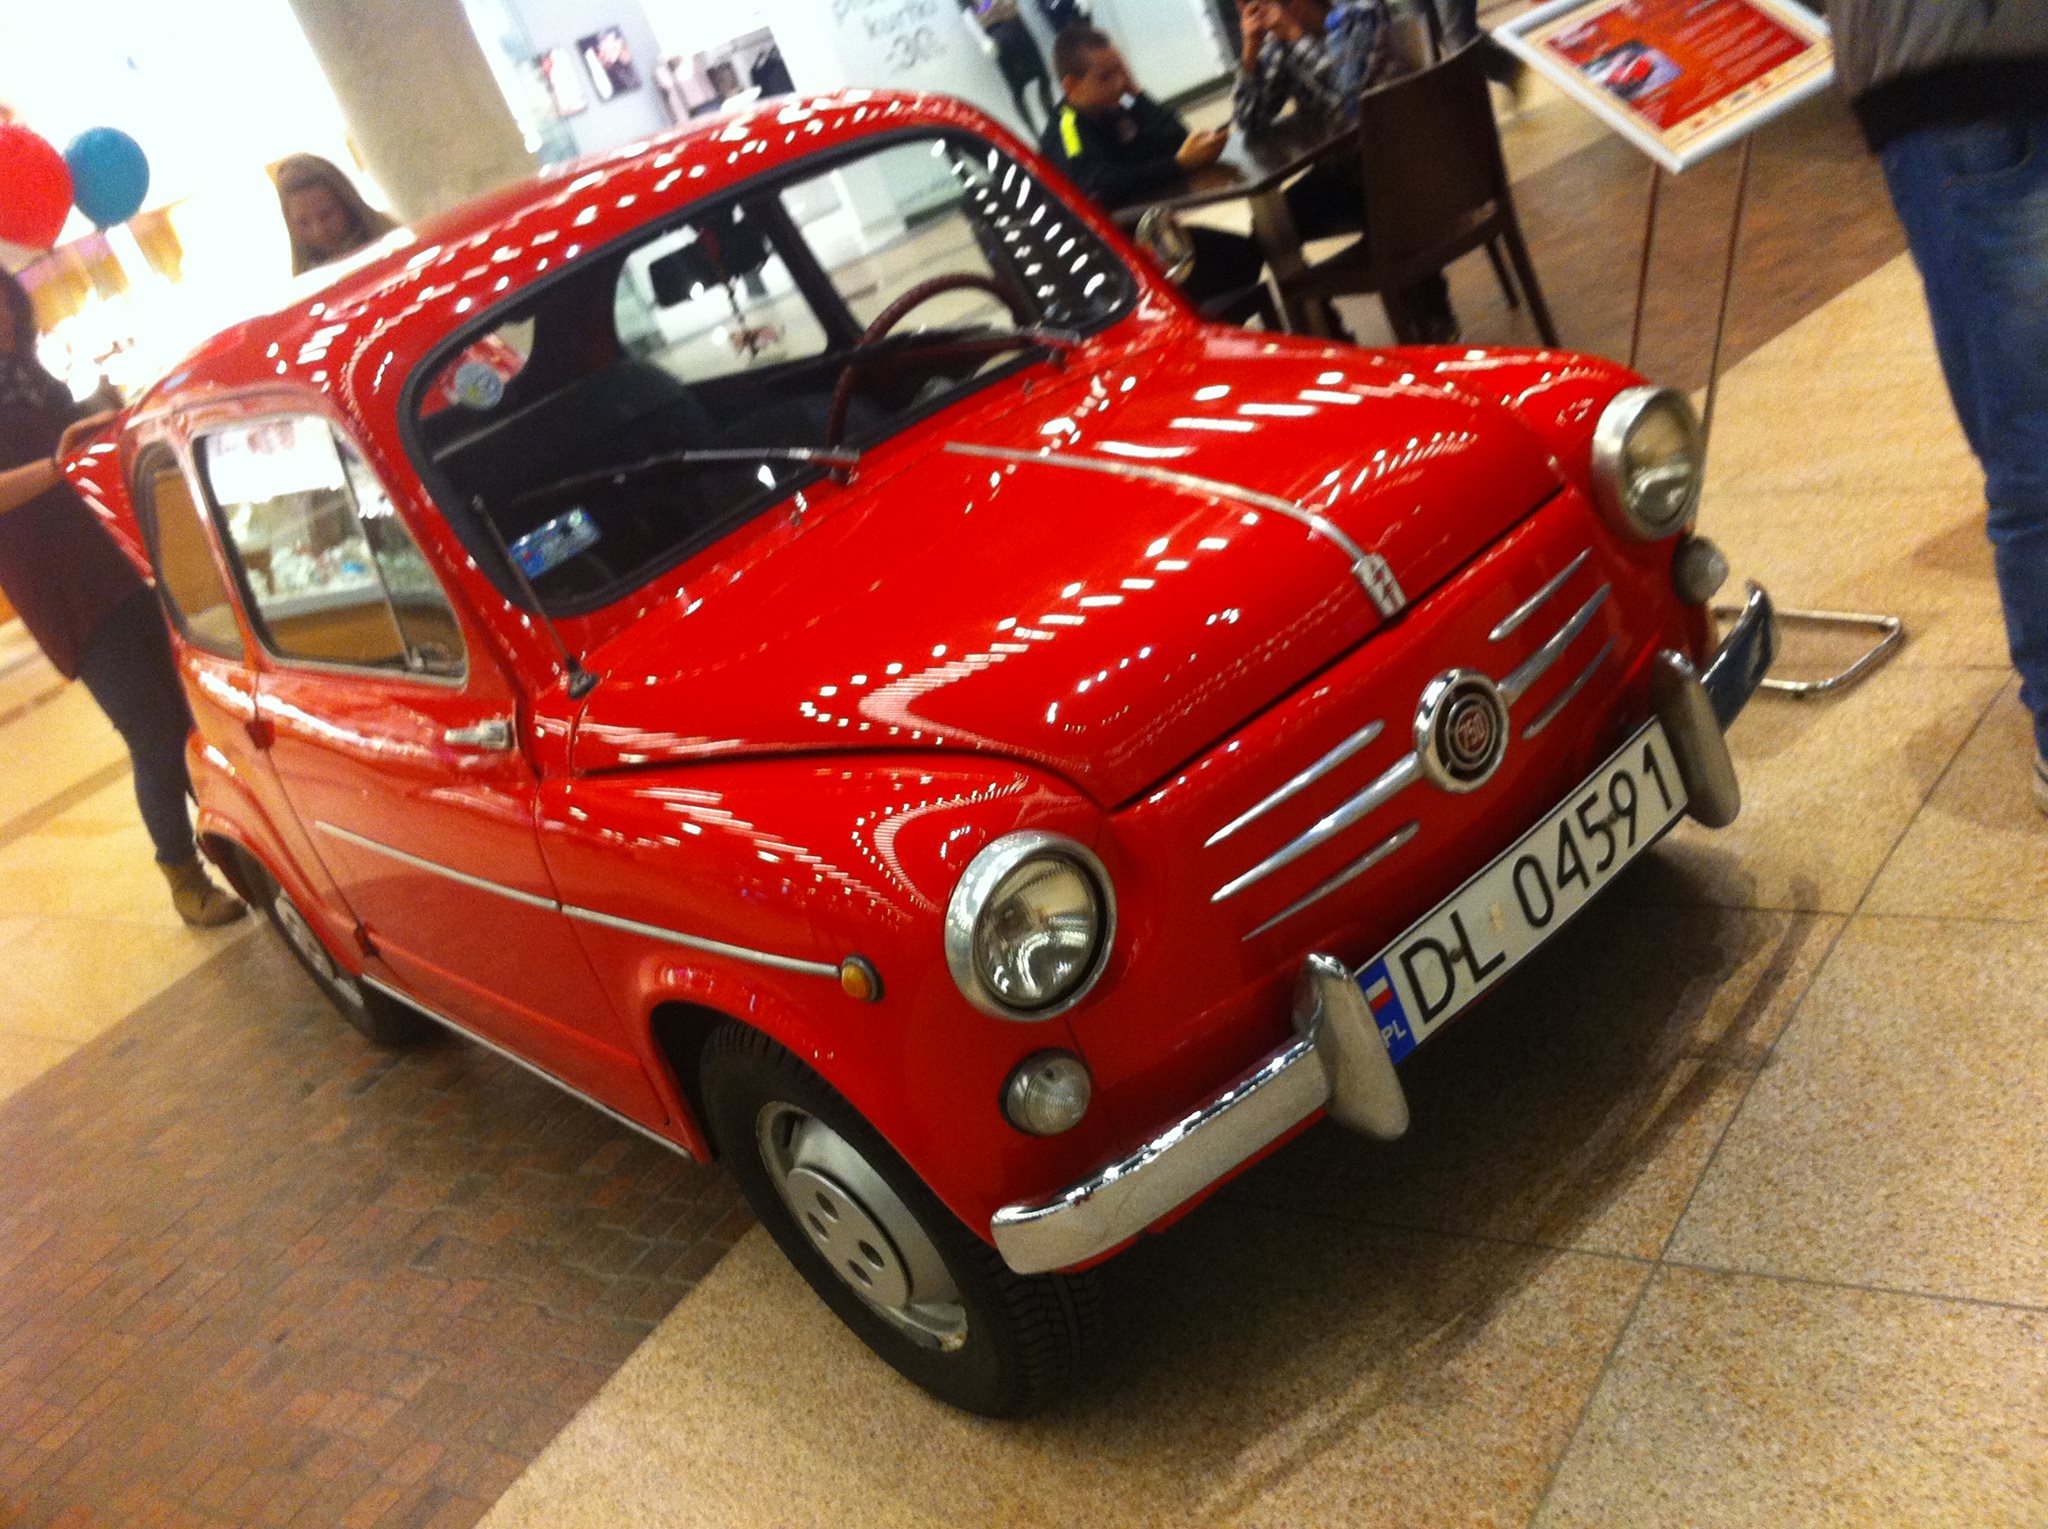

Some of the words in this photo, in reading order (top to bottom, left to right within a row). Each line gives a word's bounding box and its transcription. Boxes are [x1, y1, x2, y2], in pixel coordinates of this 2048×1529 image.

[1399, 910, 1506, 1024] DL
[1512, 743, 1672, 929] 04591
[1381, 1019, 1407, 1049] PL
